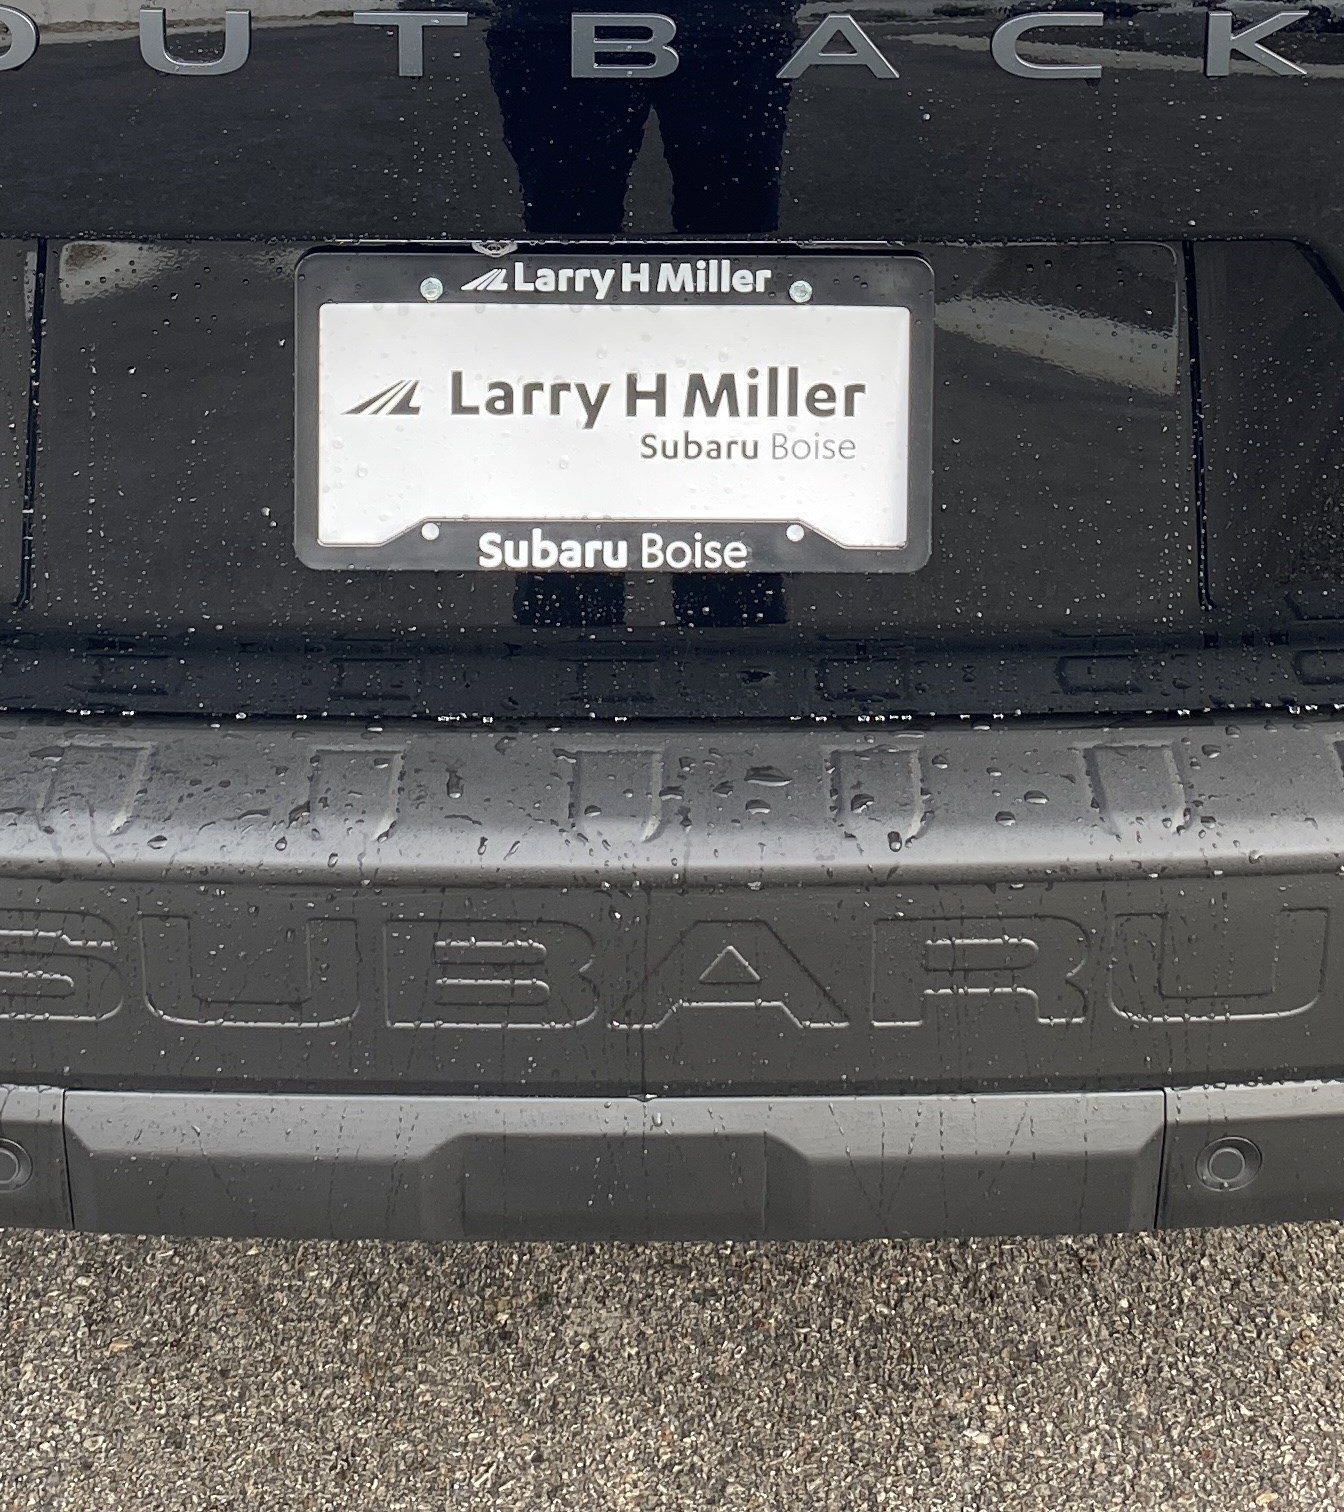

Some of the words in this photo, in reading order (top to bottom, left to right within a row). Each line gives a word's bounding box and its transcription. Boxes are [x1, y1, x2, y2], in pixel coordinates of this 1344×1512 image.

[513, 261, 614, 299] Larry
[622, 263, 649, 292] H
[656, 260, 772, 294] Miller
[450, 370, 610, 429] Larry
[626, 373, 666, 416] H
[683, 367, 866, 418] Miller
[640, 430, 759, 460] Subaru
[771, 432, 857, 460] Boise
[478, 528, 629, 568] Subaru
[641, 532, 748, 569] Boise
